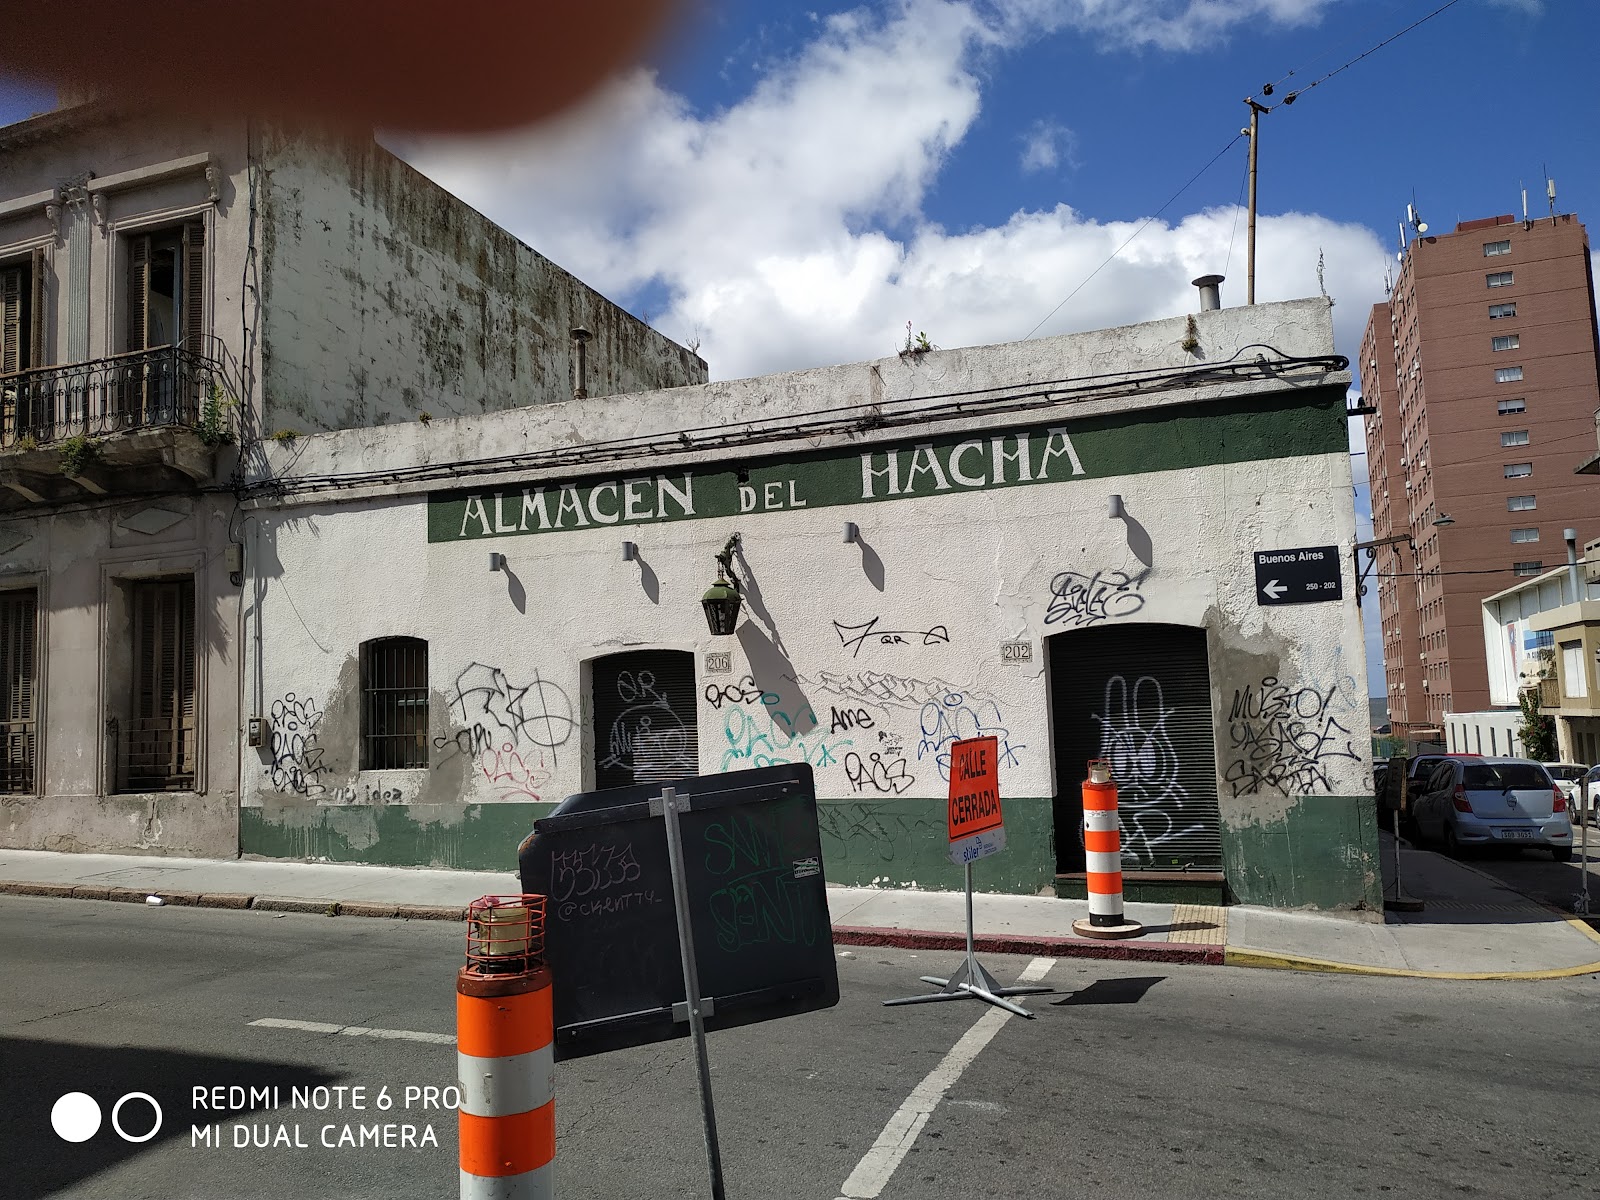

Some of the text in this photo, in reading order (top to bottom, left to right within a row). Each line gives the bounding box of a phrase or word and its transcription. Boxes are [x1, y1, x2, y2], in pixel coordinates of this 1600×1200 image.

[457, 426, 1087, 538] ALMACEN DEL HACHA
[1259, 551, 1324, 565] Buenos Aires
[1305, 582, 1318, 591] 250
[1323, 581, 1336, 590] 202
[1005, 645, 1029, 659] 202
[708, 656, 728, 670] 206
[959, 749, 987, 782] CALLE
[951, 788, 998, 827] CERRADA
